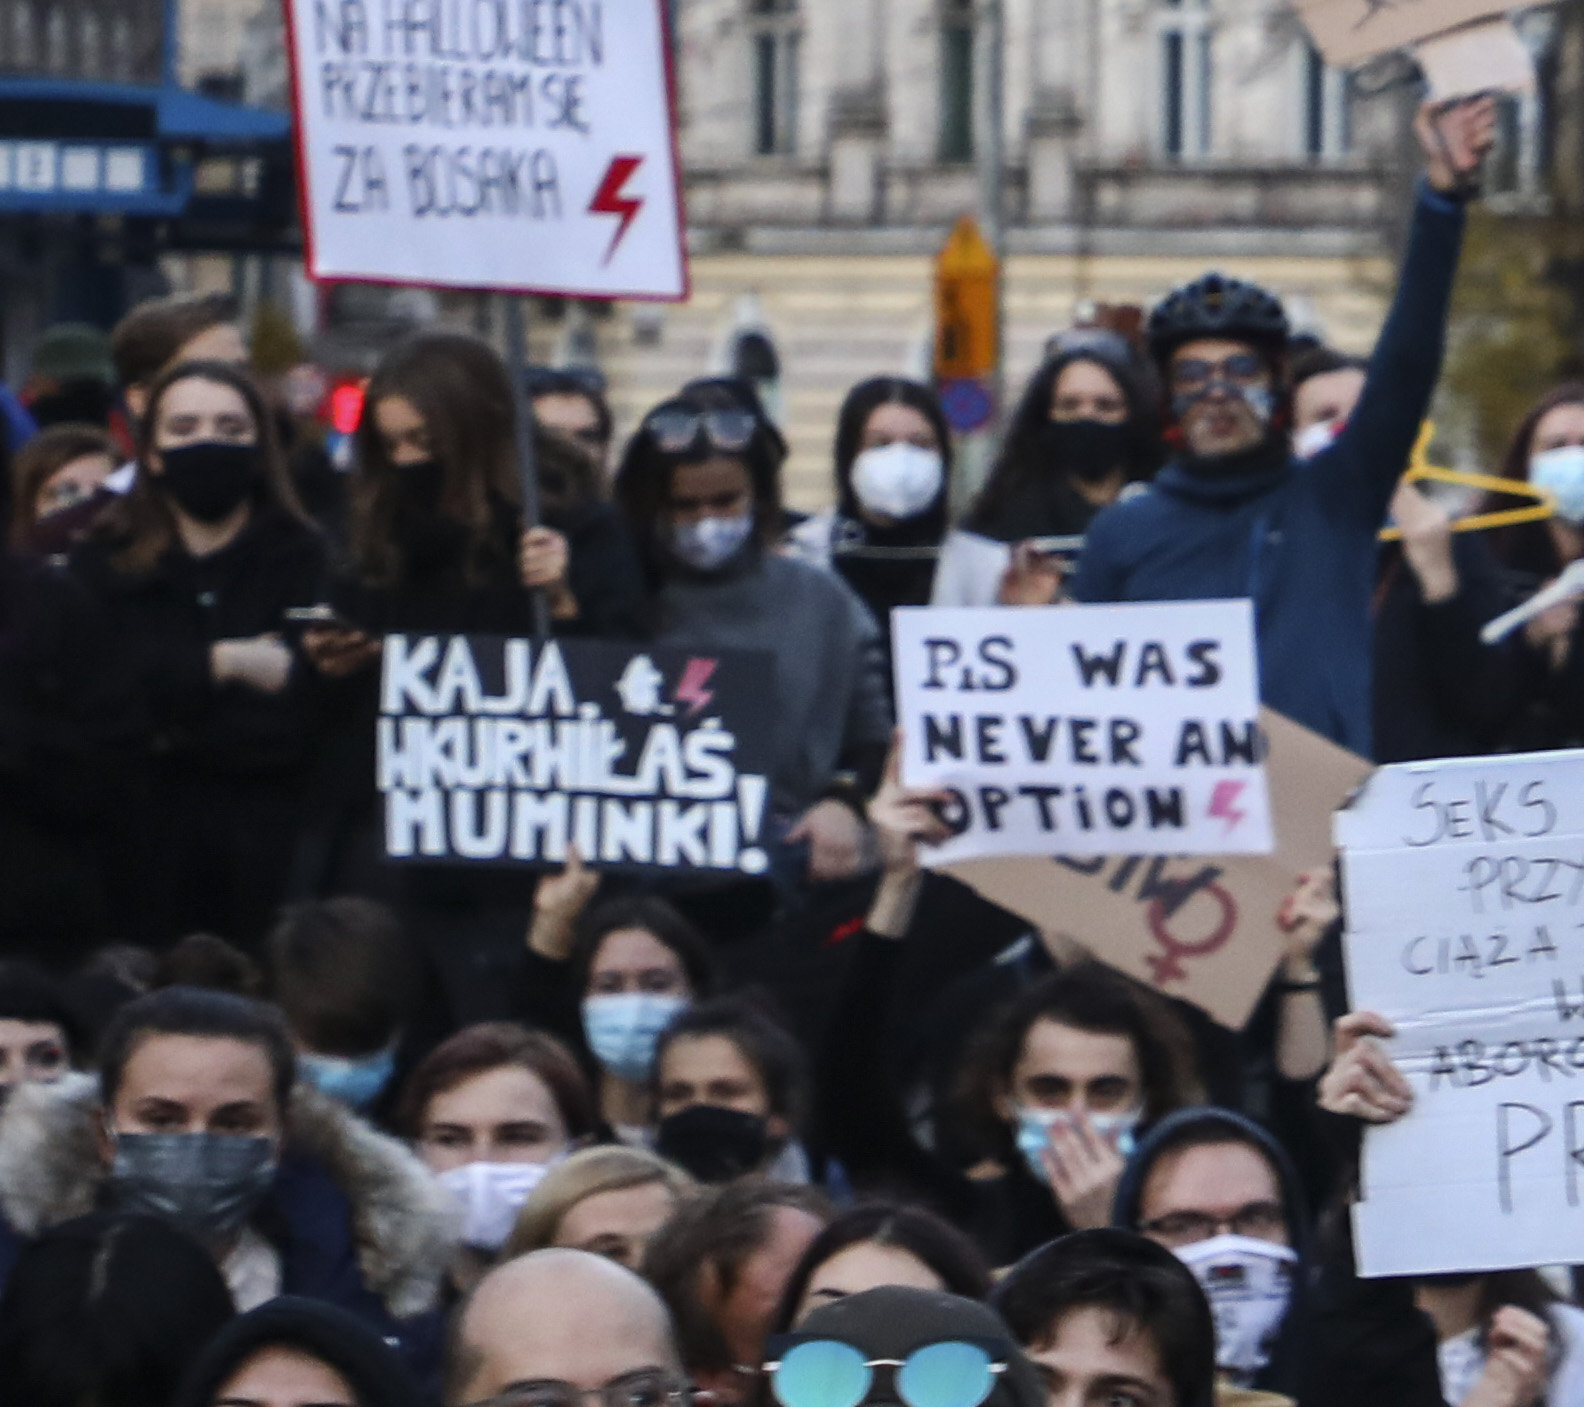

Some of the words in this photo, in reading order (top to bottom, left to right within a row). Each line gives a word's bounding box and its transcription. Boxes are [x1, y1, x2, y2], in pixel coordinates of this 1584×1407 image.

[321, 60, 534, 130] PRZEBIERAM
[332, 143, 390, 214] ZA
[403, 142, 564, 222] BOSAKA
[1070, 638, 1224, 689] WAS
[923, 714, 1142, 766] NEVER
[1175, 719, 1266, 768] AN
[385, 775, 769, 875] MUMINKI!
[1401, 779, 1558, 847] SEKS
